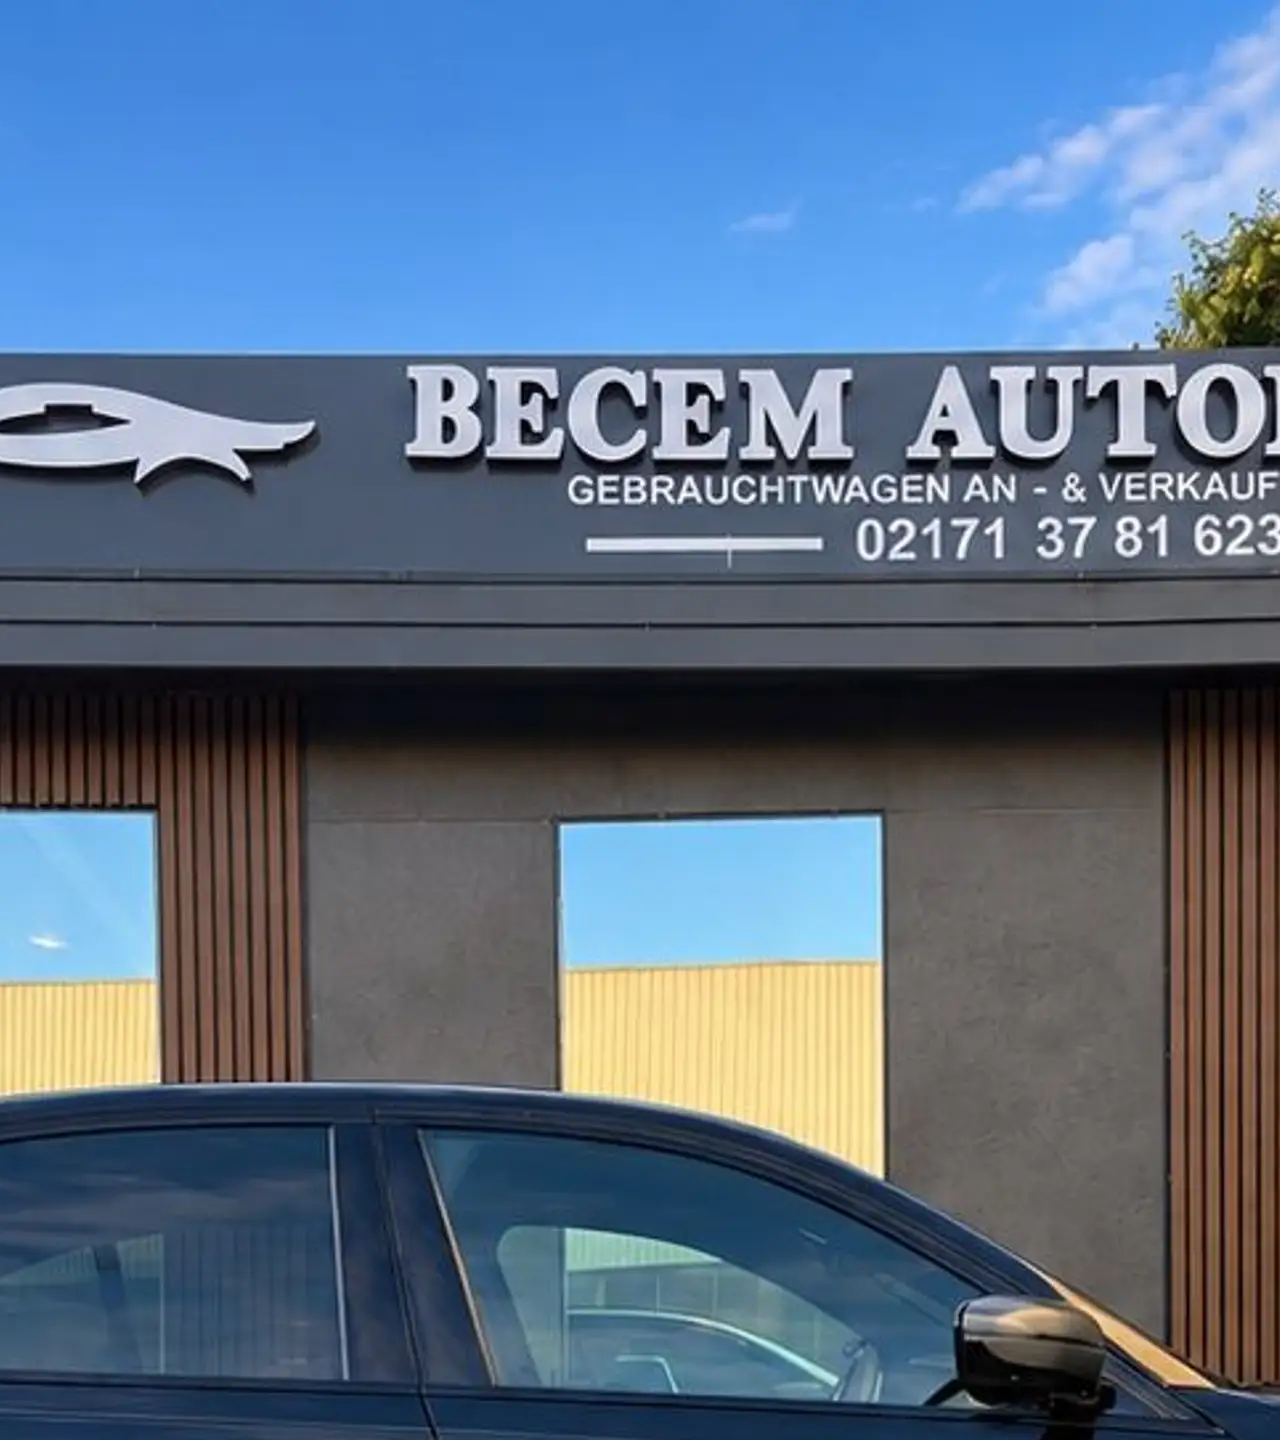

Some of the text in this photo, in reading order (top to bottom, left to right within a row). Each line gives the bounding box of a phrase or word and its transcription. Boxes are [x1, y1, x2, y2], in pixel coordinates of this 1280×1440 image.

[405, 364, 855, 461] BECEM
[567, 473, 950, 505] GEBRAUCHTWAGEN
[962, 473, 1017, 503] AN
[1061, 472, 1088, 503] &
[1098, 471, 1280, 502] VERKAUF
[856, 516, 1004, 561] 02171
[1036, 515, 1098, 559] 37
[1114, 514, 1169, 558] 81
